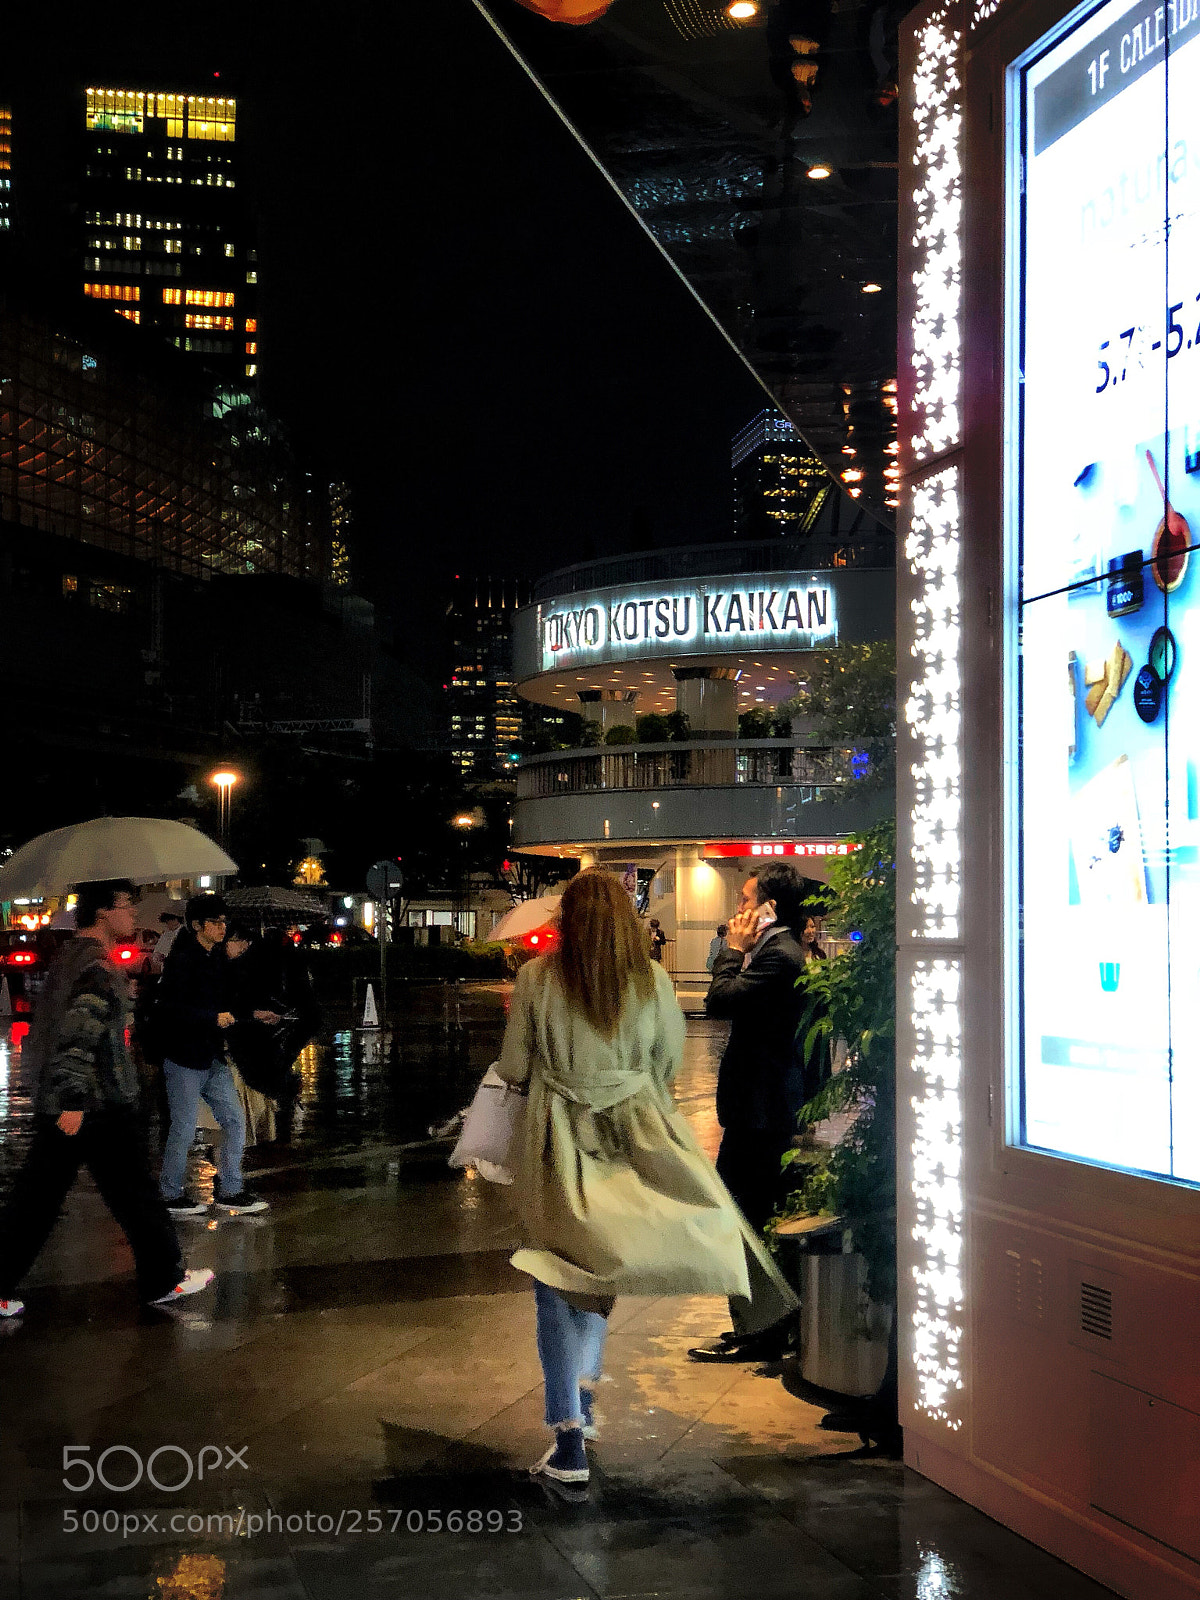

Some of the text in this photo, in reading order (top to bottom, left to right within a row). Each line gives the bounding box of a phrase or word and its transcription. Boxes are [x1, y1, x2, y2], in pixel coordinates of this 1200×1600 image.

[1087, 49, 1110, 96] 1F
[607, 596, 692, 642] KOTSU
[703, 589, 828, 633] KAIKAN
